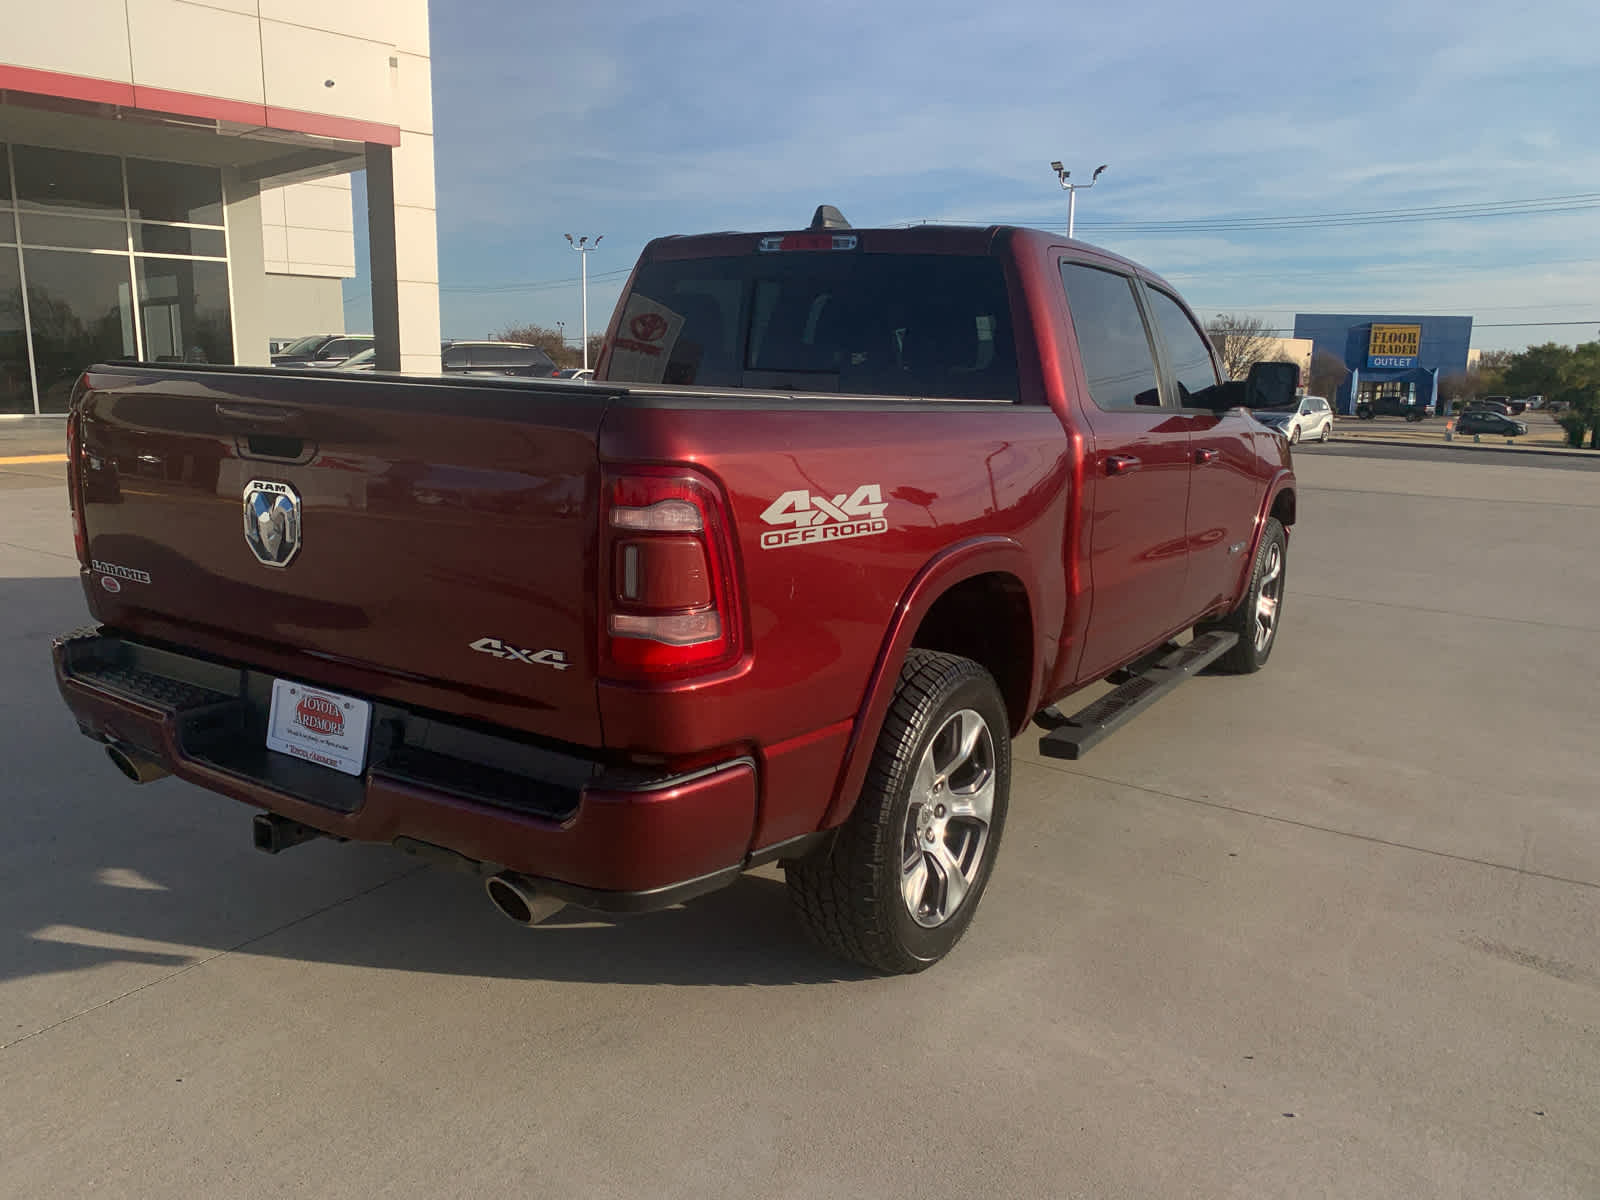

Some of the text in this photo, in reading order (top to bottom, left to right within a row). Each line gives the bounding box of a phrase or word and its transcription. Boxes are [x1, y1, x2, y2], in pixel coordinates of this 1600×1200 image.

[1373, 332, 1416, 344] FLOOR
[1371, 344, 1417, 354] TRADER
[1374, 357, 1412, 367] OUTLET
[253, 482, 286, 492] RAM
[763, 519, 886, 547] OFF ROAD
[92, 560, 151, 584] LARAMIE
[302, 694, 340, 717] TOYOTA
[294, 710, 344, 736] ARDMORE
